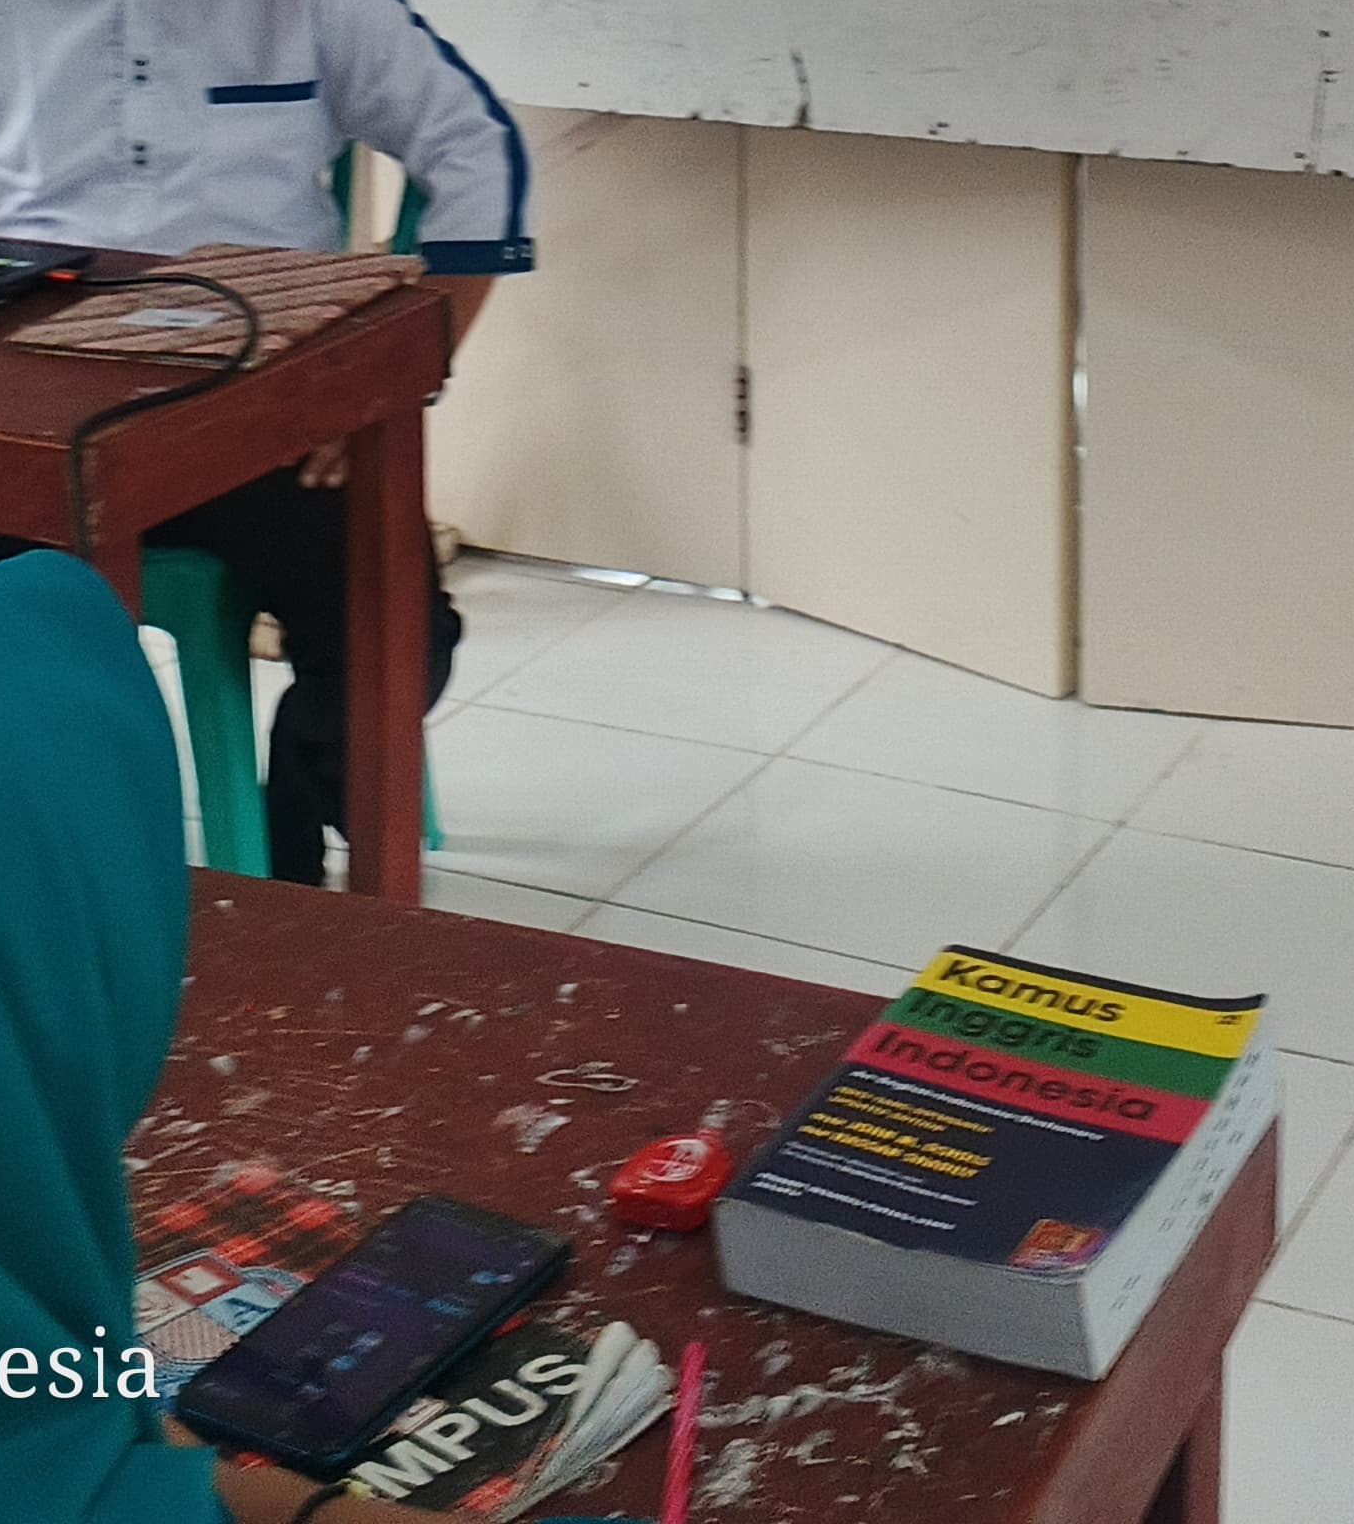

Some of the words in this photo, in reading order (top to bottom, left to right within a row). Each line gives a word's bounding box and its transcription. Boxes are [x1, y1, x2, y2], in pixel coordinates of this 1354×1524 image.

[908, 989, 1106, 1059] Inggris
[940, 958, 1127, 1023] Kamus
[874, 1028, 1160, 1121] Indonesia
